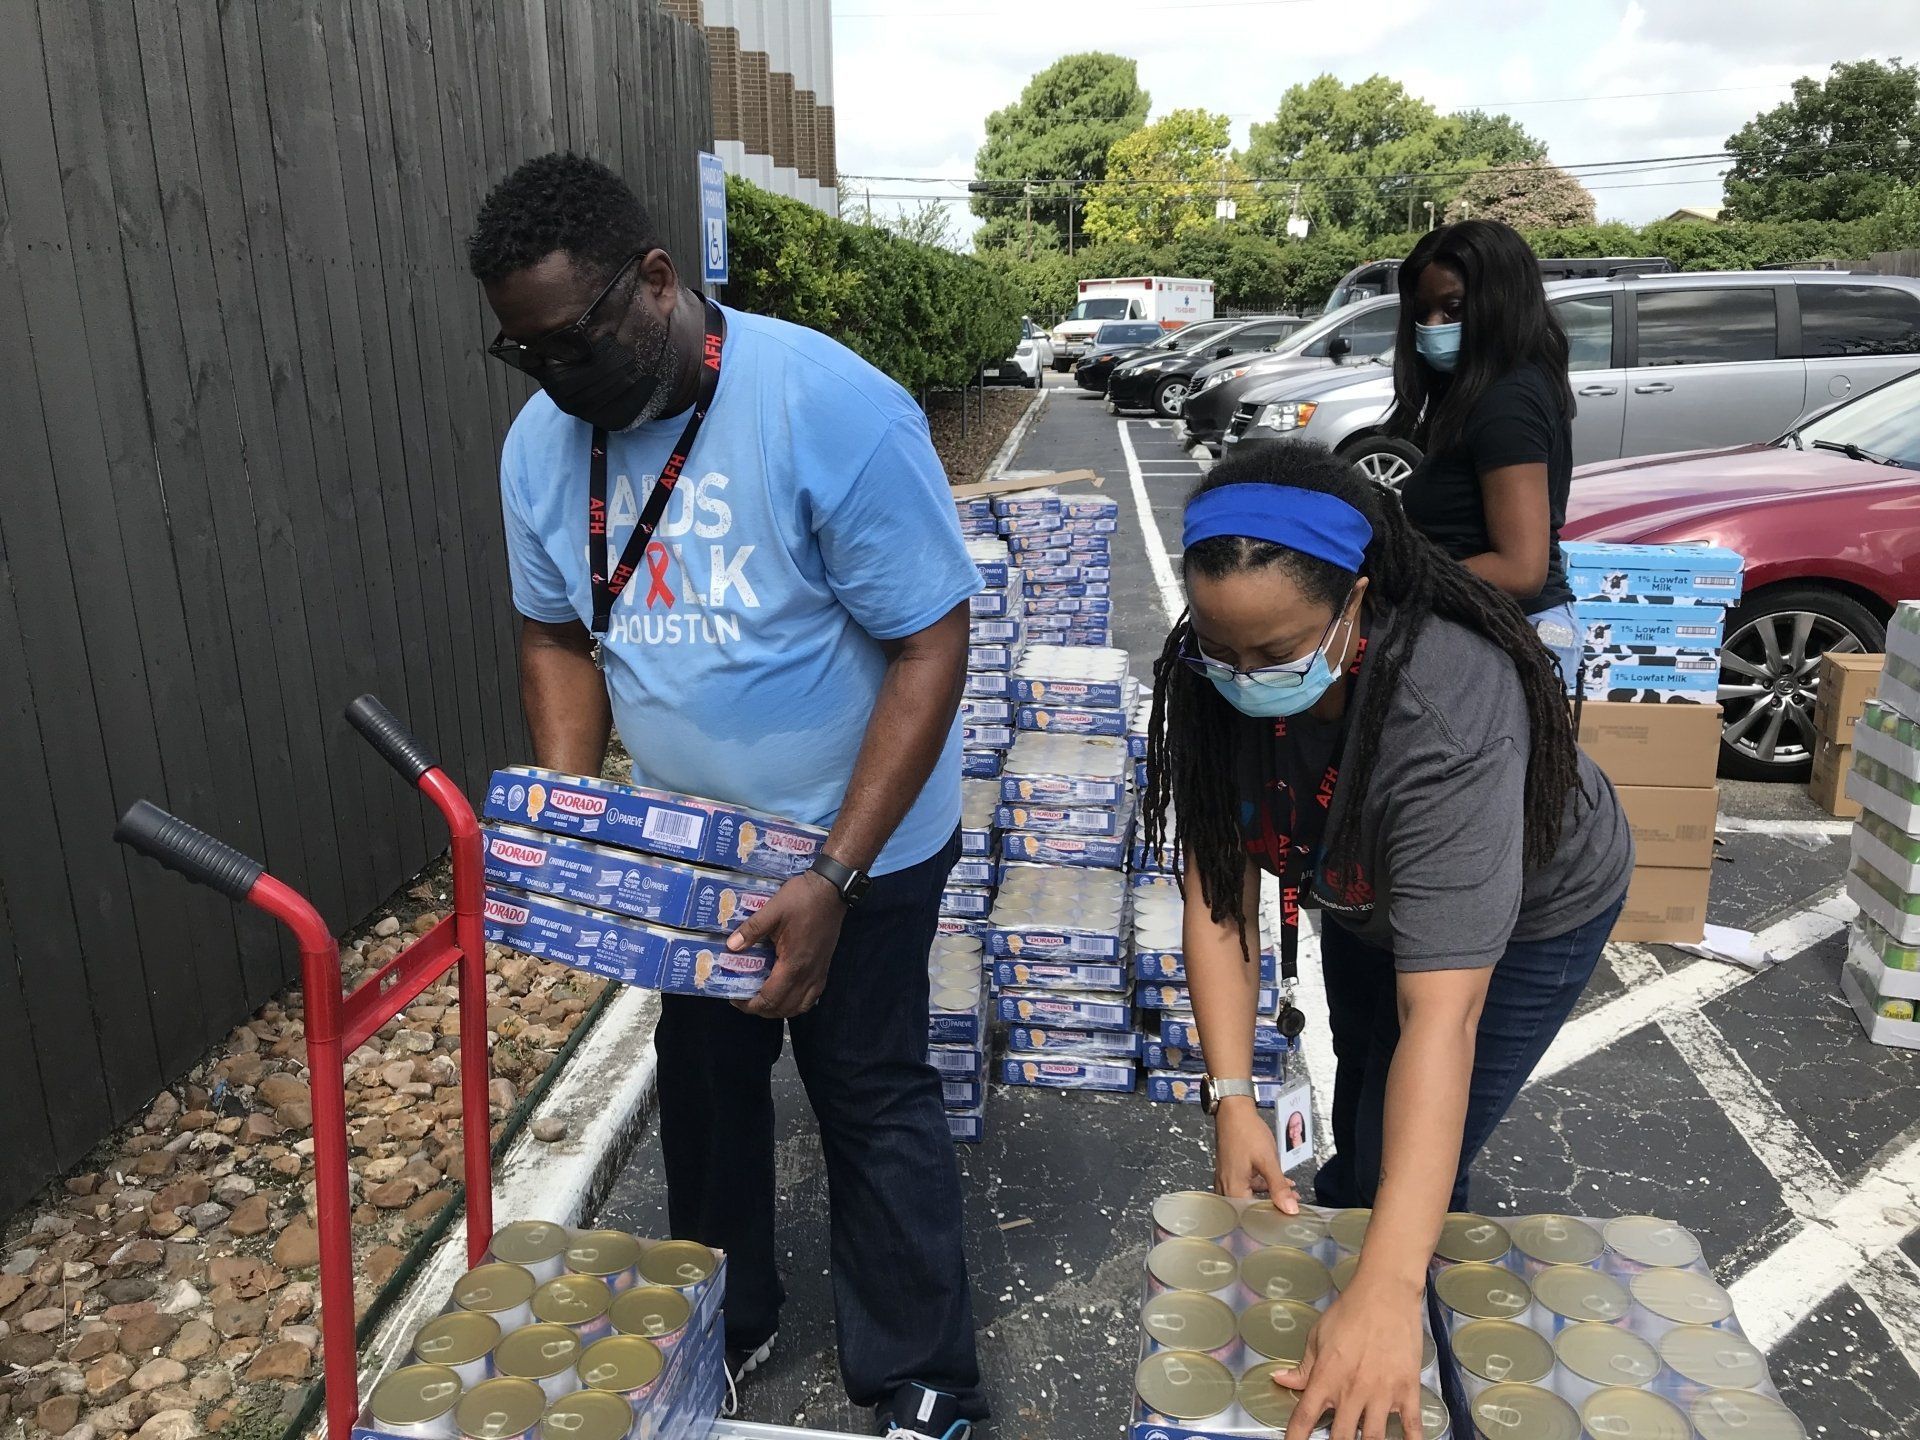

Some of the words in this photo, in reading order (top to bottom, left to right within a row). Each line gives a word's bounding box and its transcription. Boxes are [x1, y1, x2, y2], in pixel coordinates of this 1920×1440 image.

[704, 334, 721, 370] AFH
[659, 453, 686, 491] AFH
[590, 497, 605, 534] AFH
[608, 564, 633, 595] AFH
[1638, 575, 1650, 583] 1%
[1653, 575, 1688, 584] Lowfat
[1652, 584, 1672, 592] Milk
[1621, 625, 1633, 633] 1%
[1636, 626, 1670, 634] Lowfat
[1635, 633, 1654, 641] Milk
[1615, 673, 1628, 681] 1%
[1631, 673, 1664, 682] Lowfat
[1667, 674, 1687, 683] Milk
[1315, 766, 1339, 809] AFH
[556, 794, 603, 813] DORADO
[618, 813, 644, 828] PAREVE
[771, 835, 812, 852] DORADO
[497, 844, 542, 864] DORADO
[527, 878, 549, 889] DORADO
[651, 881, 669, 892] PAREVE
[571, 889, 595, 900] DORADO
[618, 901, 643, 912] DORADO
[1283, 887, 1298, 927] AFH
[509, 937, 531, 948] DORADO
[551, 949, 574, 961] DORADO
[627, 943, 645, 955] PAREVE
[596, 962, 620, 975] DORADO
